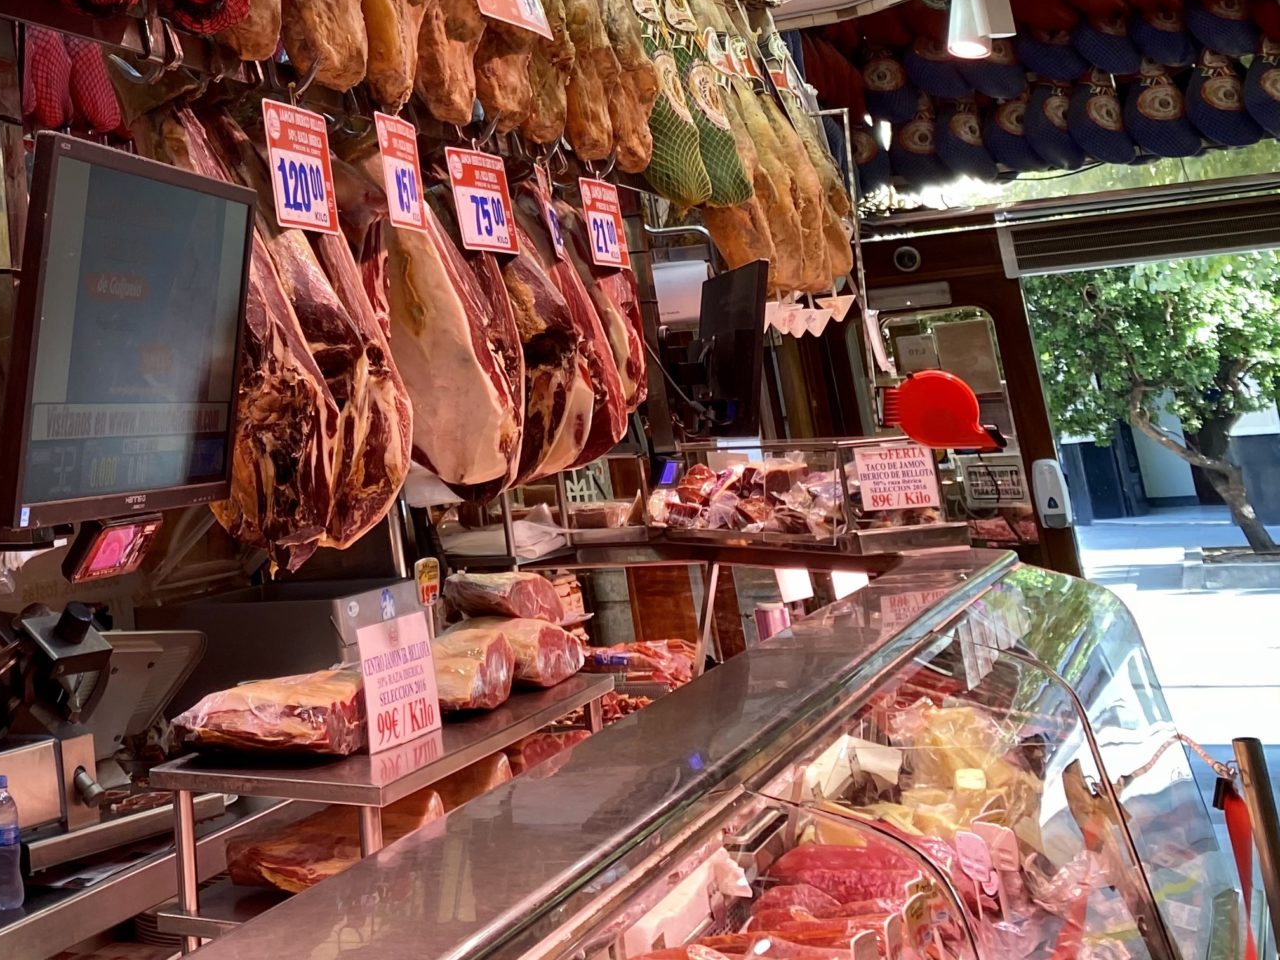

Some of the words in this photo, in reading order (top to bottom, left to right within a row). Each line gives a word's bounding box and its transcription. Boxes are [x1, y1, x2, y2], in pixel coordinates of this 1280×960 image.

[315, 212, 328, 223] KILO
[860, 470, 890, 481] IBERICO
[891, 470, 900, 479] DE
[901, 468, 934, 478] BELLOTA
[865, 462, 886, 472] TACO
[887, 462, 898, 470] DE
[899, 460, 926, 469] JAMON
[871, 492, 894, 507] 89€
[896, 491, 901, 506] /
[904, 489, 931, 505] Kilo
[363, 654, 384, 677] CENTRO
[384, 648, 401, 673] JAMON
[408, 641, 431, 665] BELLOTA
[379, 685, 414, 707] SELECCION
[377, 708, 400, 746] 99€
[410, 697, 434, 732] Kilo
